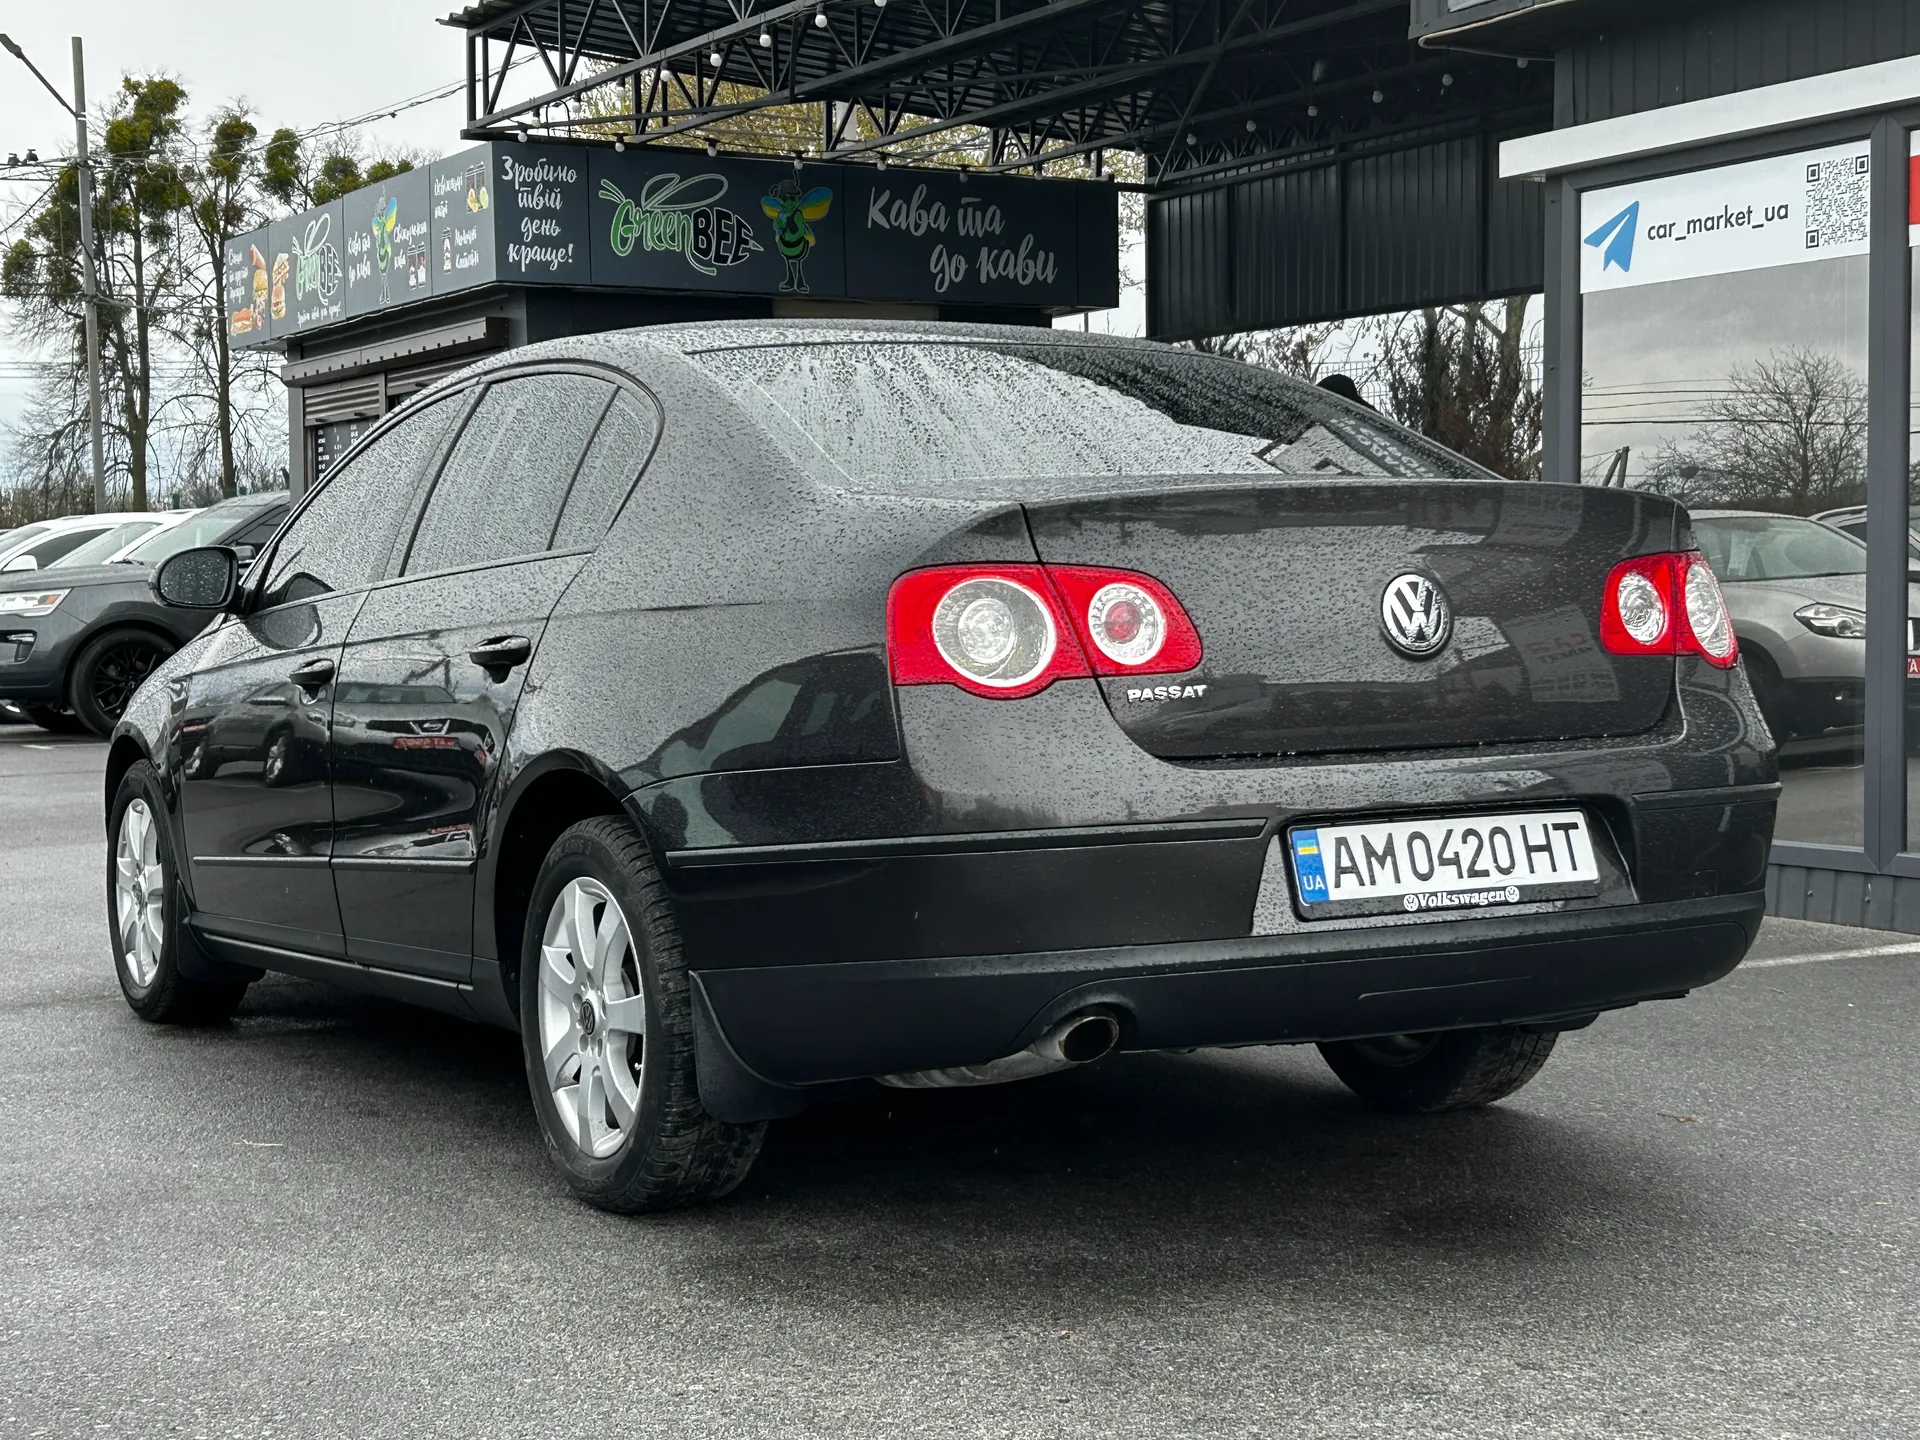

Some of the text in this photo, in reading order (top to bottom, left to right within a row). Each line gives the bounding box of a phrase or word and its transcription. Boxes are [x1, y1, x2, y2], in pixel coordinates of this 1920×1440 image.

[518, 182, 564, 211] твій
[867, 183, 1006, 238] Кава та
[520, 216, 562, 243] день
[1646, 203, 1790, 242] car_market_ua
[507, 243, 575, 273] краще!
[930, 233, 1058, 294] до кави
[1126, 684, 1208, 703] PASSAT
[1302, 875, 1326, 892] UA
[1417, 889, 1507, 906] Volkswagen
